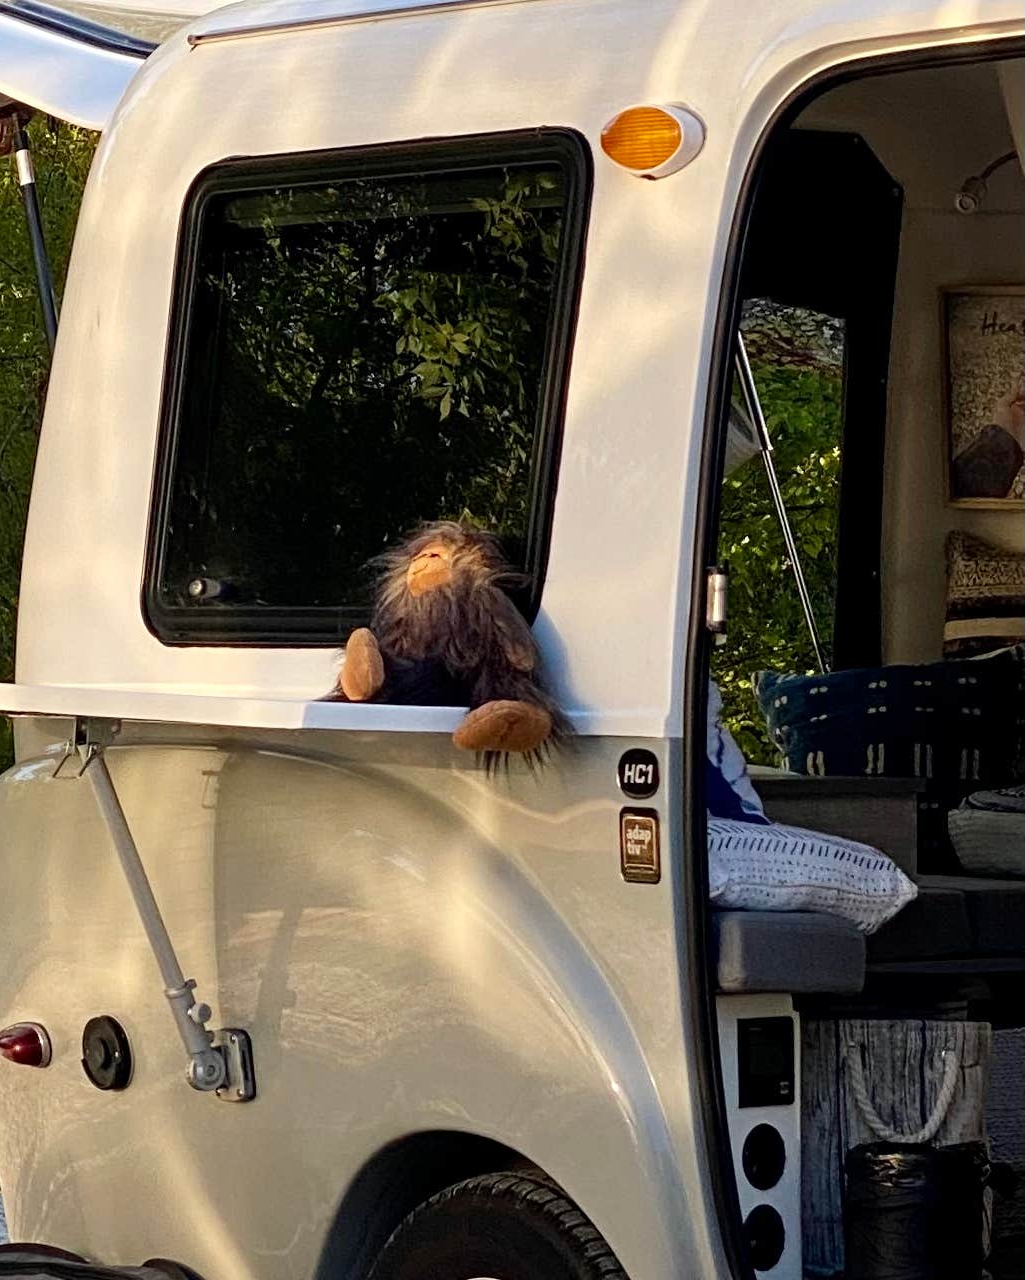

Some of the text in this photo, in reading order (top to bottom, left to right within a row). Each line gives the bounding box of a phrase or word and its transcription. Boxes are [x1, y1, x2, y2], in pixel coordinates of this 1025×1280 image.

[982, 311, 1025, 336] Hea
[624, 763, 654, 784] HC1
[626, 824, 652, 846] adap
